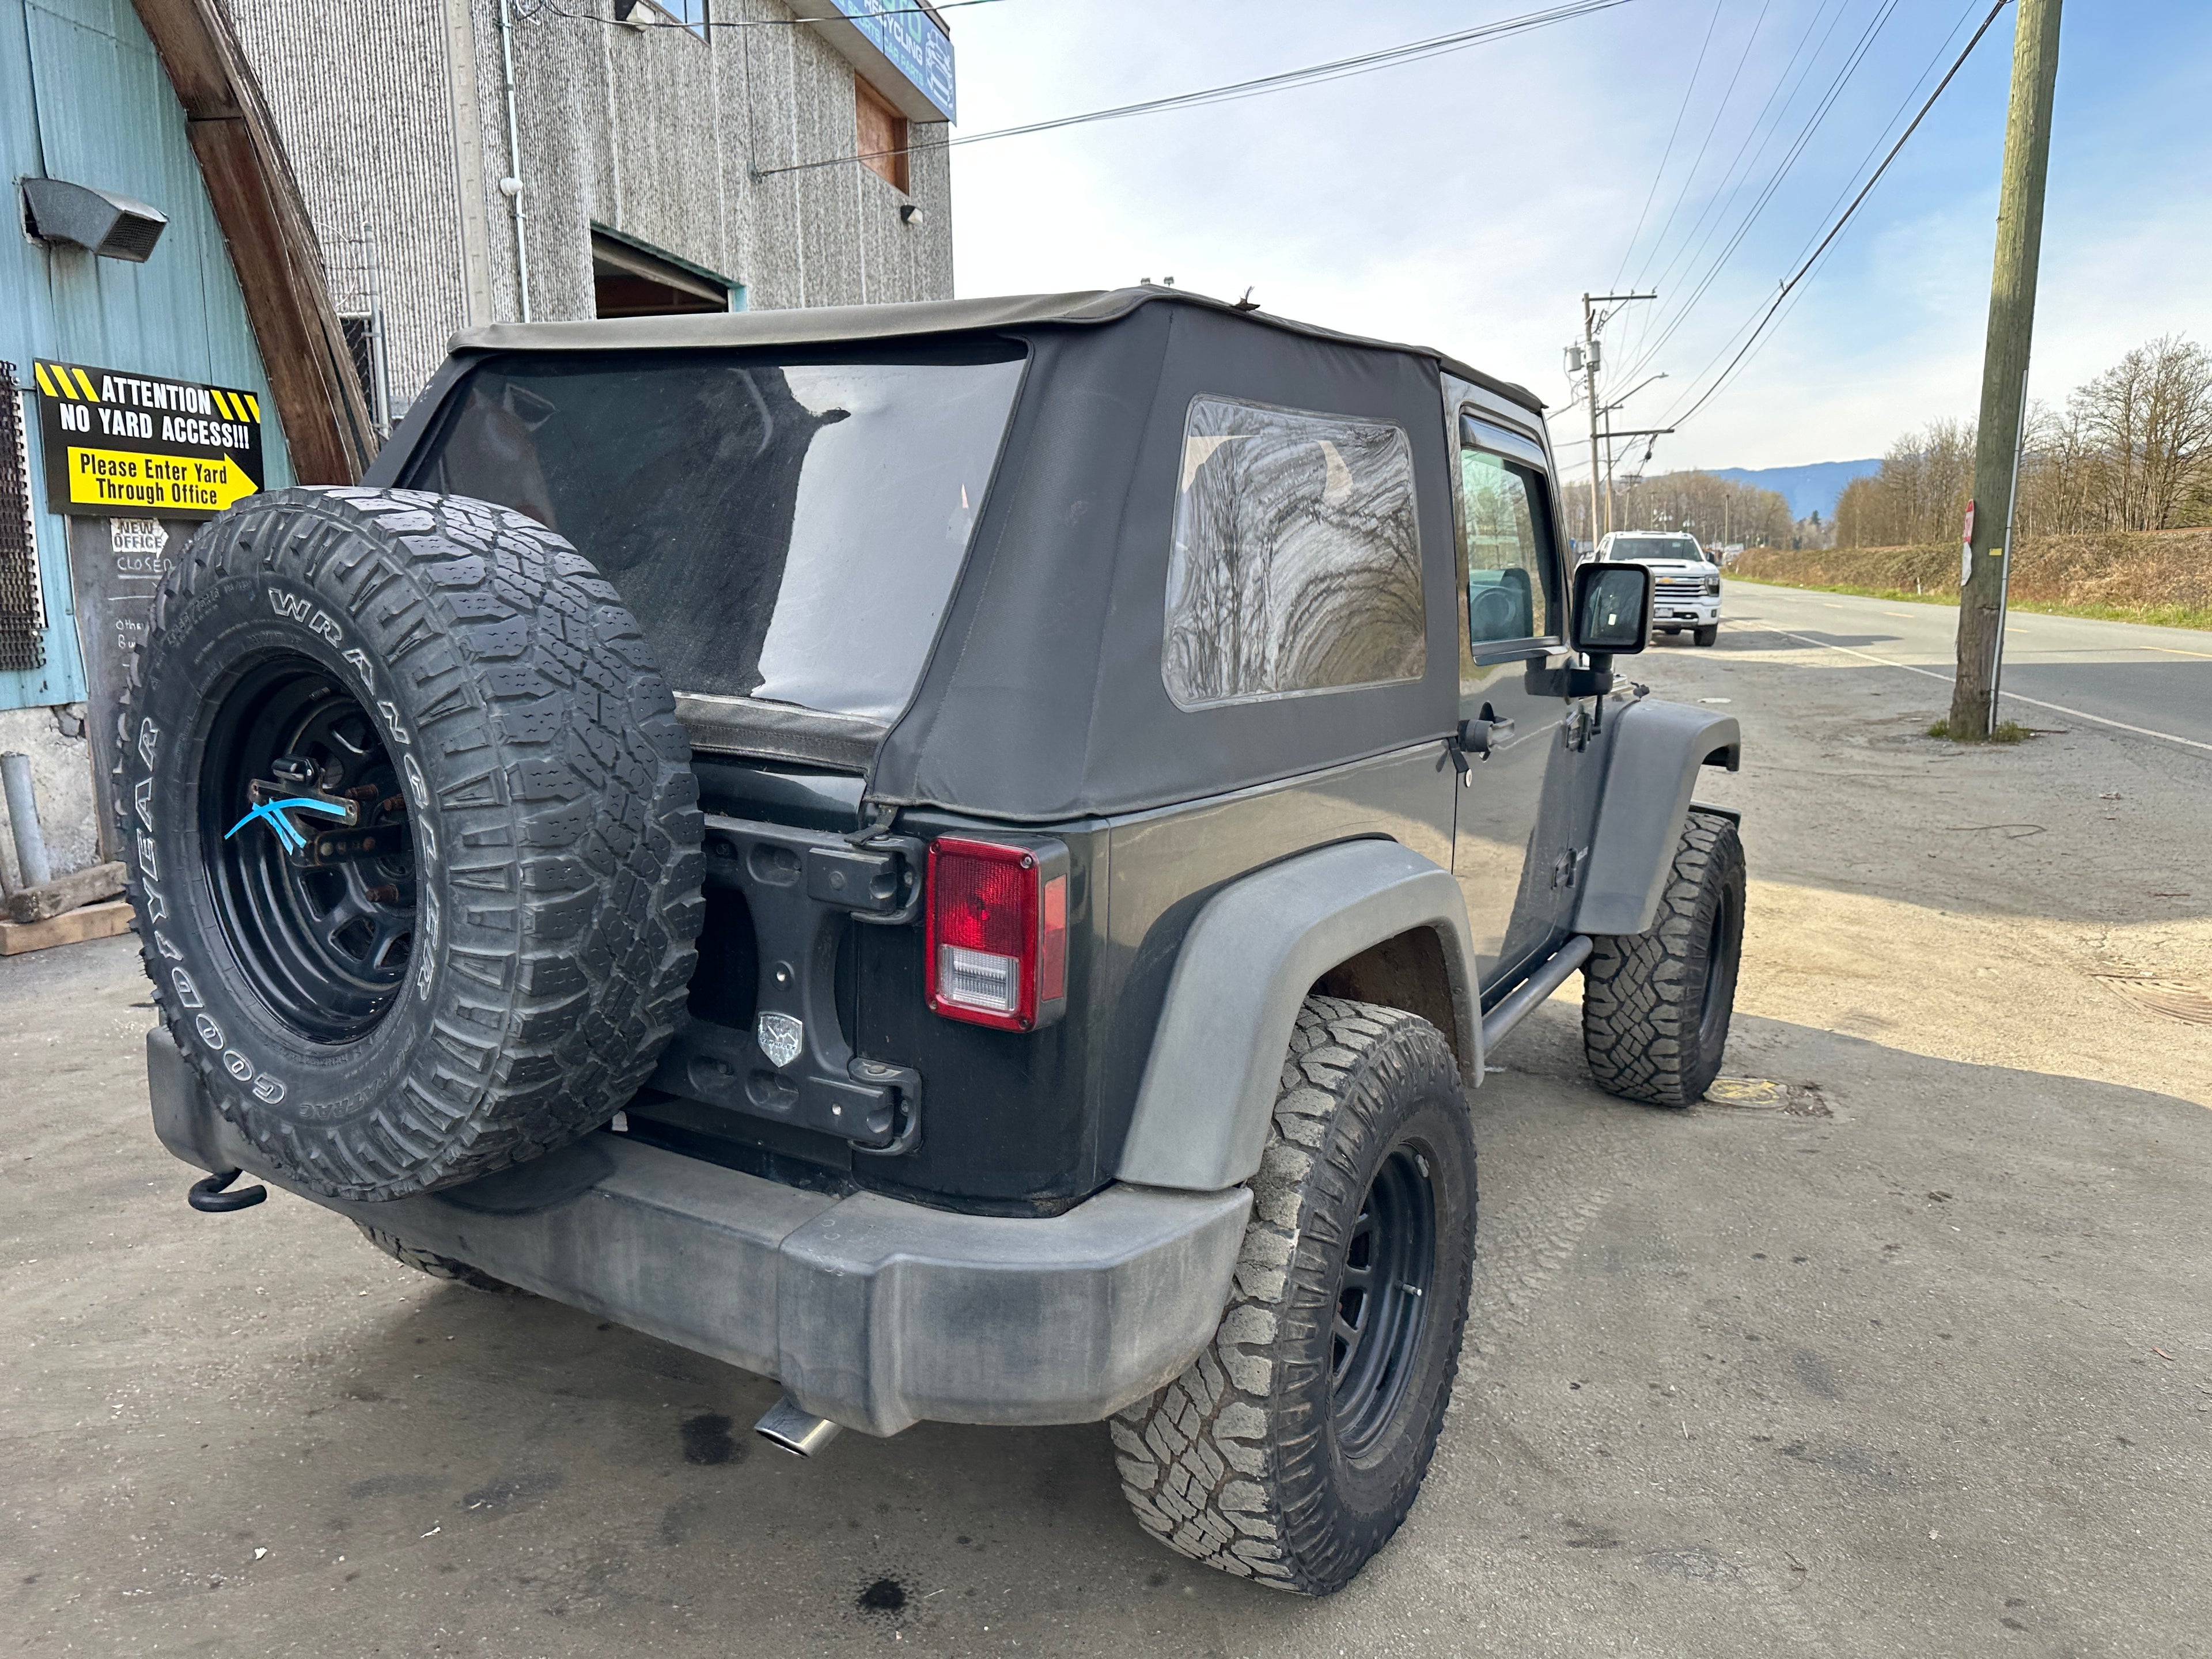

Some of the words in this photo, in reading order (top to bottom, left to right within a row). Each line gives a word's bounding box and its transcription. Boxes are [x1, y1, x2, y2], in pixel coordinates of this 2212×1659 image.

[884, 36, 899, 62] CAR
[900, 54, 924, 86] PARTS
[101, 375, 212, 415] ATTENTION
[59, 403, 90, 433] NO
[97, 407, 153, 439] YARD
[162, 415, 250, 449] ACCESS!!!
[80, 453, 137, 478] Please
[145, 459, 187, 482] Enter
[194, 463, 227, 484] Yard
[96, 478, 164, 505] Through
[172, 483, 218, 505] Office
[114, 533, 164, 548] OFFICE
[120, 521, 153, 534] NEW
[268, 587, 440, 1001] WRANGLER
[135, 716, 285, 1104] GOODYEAR
